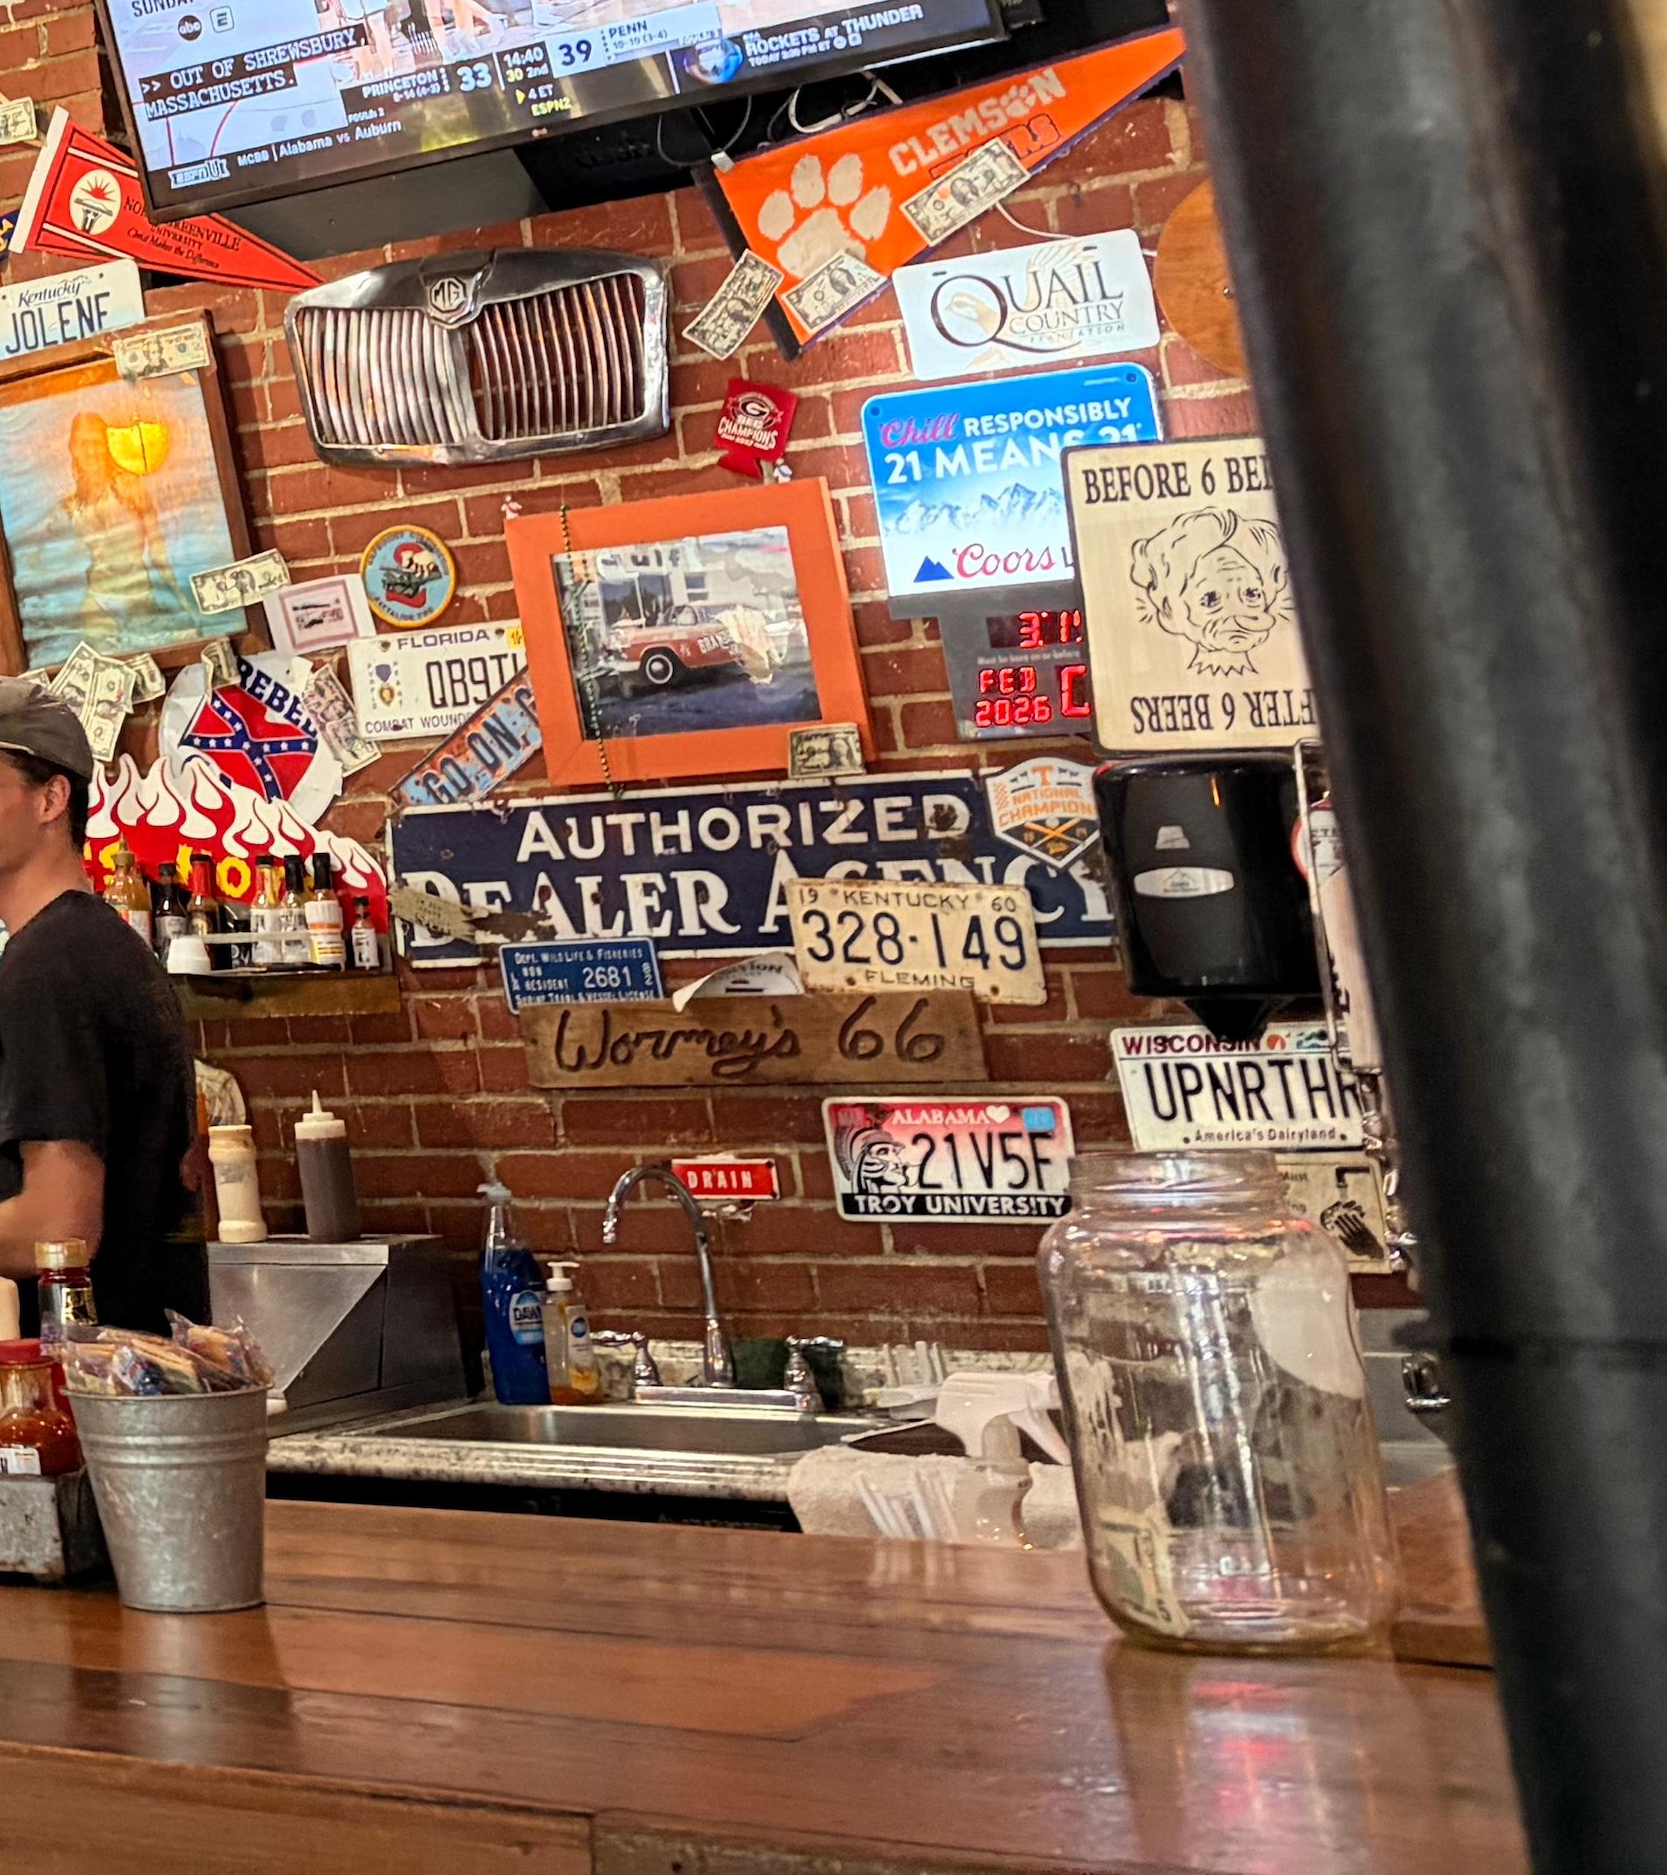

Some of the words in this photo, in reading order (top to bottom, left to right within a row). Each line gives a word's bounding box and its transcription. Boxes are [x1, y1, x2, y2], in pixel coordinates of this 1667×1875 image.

[608, 20, 648, 40] PENN
[744, 24, 821, 55] ROCKETS
[841, 2, 925, 37] THUNDER
[502, 48, 545, 69] 14:40
[557, 39, 594, 68] 39
[170, 67, 206, 89] OUT
[212, 61, 236, 81] OF
[362, 70, 440, 100] PRINCETON
[457, 67, 492, 93] 33
[531, 97, 573, 118] ESPN2
[279, 135, 334, 161] Alabama
[353, 118, 403, 142] Auburn
[18, 275, 84, 310] Kentucky
[929, 258, 1125, 354] QUAIL
[1008, 302, 1125, 335] COUNTRY
[718, 416, 779, 450] CHAMPIONS
[879, 412, 961, 449] Chill
[964, 397, 1133, 437] RESPONSIBLY
[884, 451, 924, 484] 21
[1083, 460, 1192, 505] BEFORE
[1201, 459, 1216, 495] 6
[953, 542, 1057, 580] Coors
[397, 628, 491, 651] FLORIDA
[979, 668, 1038, 695] FEB
[365, 716, 416, 735] COMBAT
[974, 695, 1054, 727] 2026
[1131, 693, 1212, 733] BEERS
[1012, 788, 1082, 805] NATIONAL
[515, 792, 972, 863] AUTHORIZED
[400, 862, 743, 948] DEALER
[800, 887, 818, 905] 19
[840, 889, 971, 912] KENTUCKY
[990, 894, 1019, 914] 60
[581, 964, 633, 989] 2681
[863, 969, 977, 991] FLEMING
[554, 1006, 801, 1079] Wormey's
[836, 995, 946, 1064] 66
[892, 1107, 990, 1126] ALABAMA
[1194, 1127, 1264, 1145] America's
[1268, 1127, 1337, 1144] Dairyland
[686, 1169, 754, 1190] DRAIN
[854, 1194, 916, 1216] TROY
[923, 1194, 1068, 1217] UNIVERSITY
